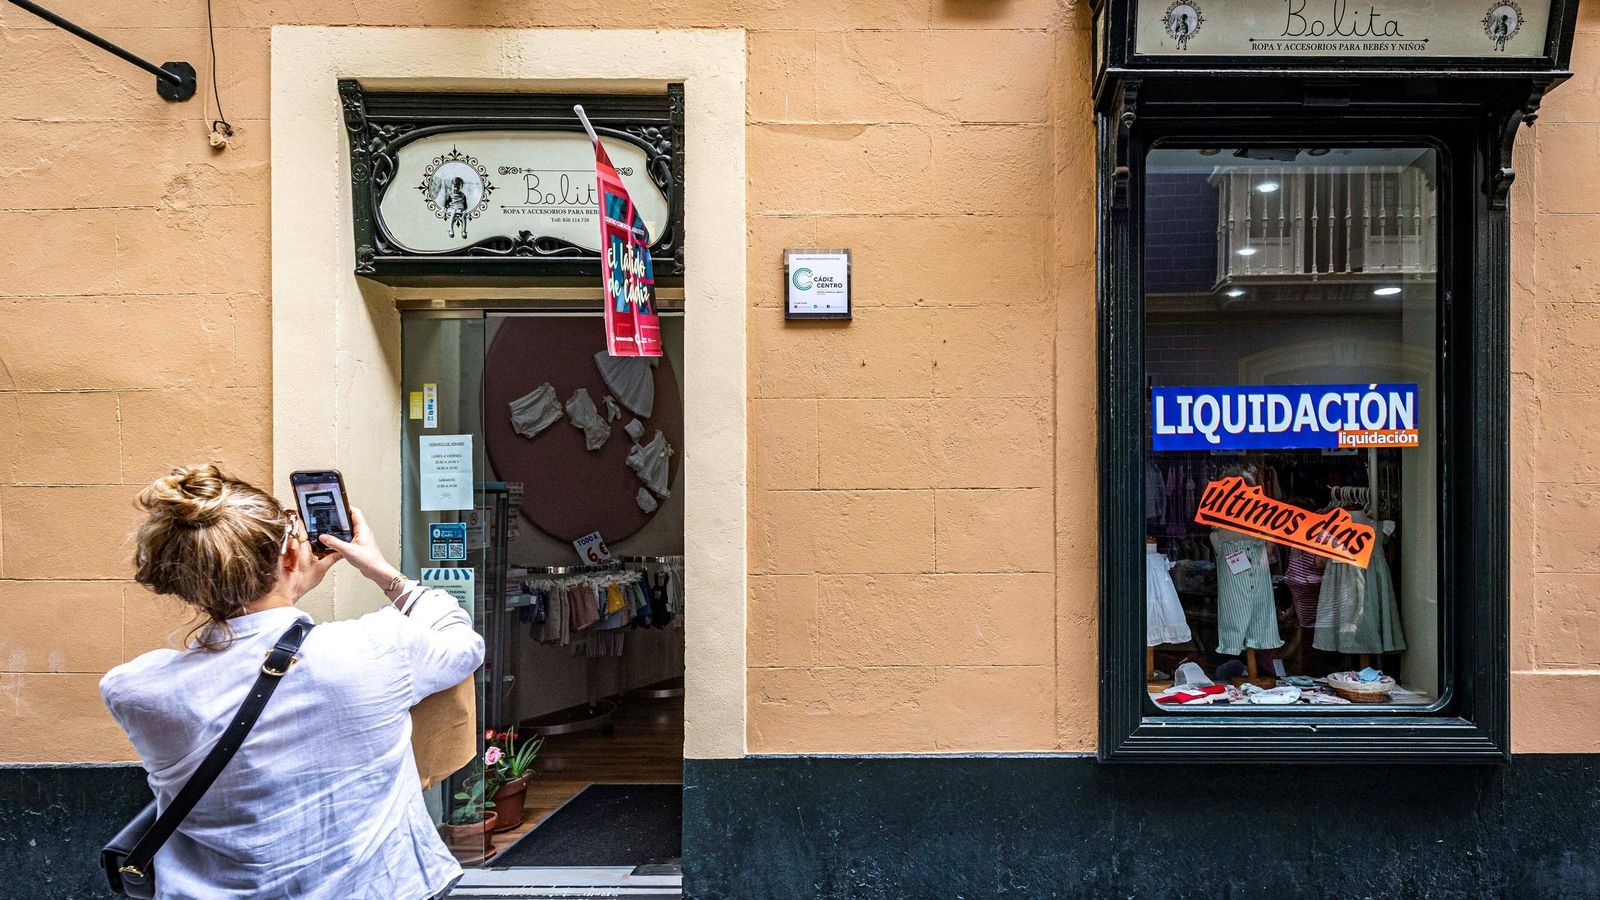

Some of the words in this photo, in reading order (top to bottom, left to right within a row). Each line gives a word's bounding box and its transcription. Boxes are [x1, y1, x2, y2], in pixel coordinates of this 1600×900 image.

[1281, 0, 1404, 37] Bolita
[1283, 43, 1337, 51] ACCESORIOS
[1339, 43, 1360, 51] PARA
[1363, 42, 1389, 51] BEBÉS
[1399, 42, 1426, 51] NIÑOS
[523, 174, 599, 205] Bolit
[608, 242, 618, 269] El
[620, 240, 645, 278] latido
[608, 271, 621, 298] de
[624, 277, 650, 306] Cádiz
[1155, 384, 1413, 443] LIQUIDACIÓN
[1339, 431, 1418, 445] liquidación
[1200, 479, 1307, 535] últimos
[1305, 508, 1372, 555] días
[577, 536, 593, 546] TODO
[587, 547, 598, 562] 6
